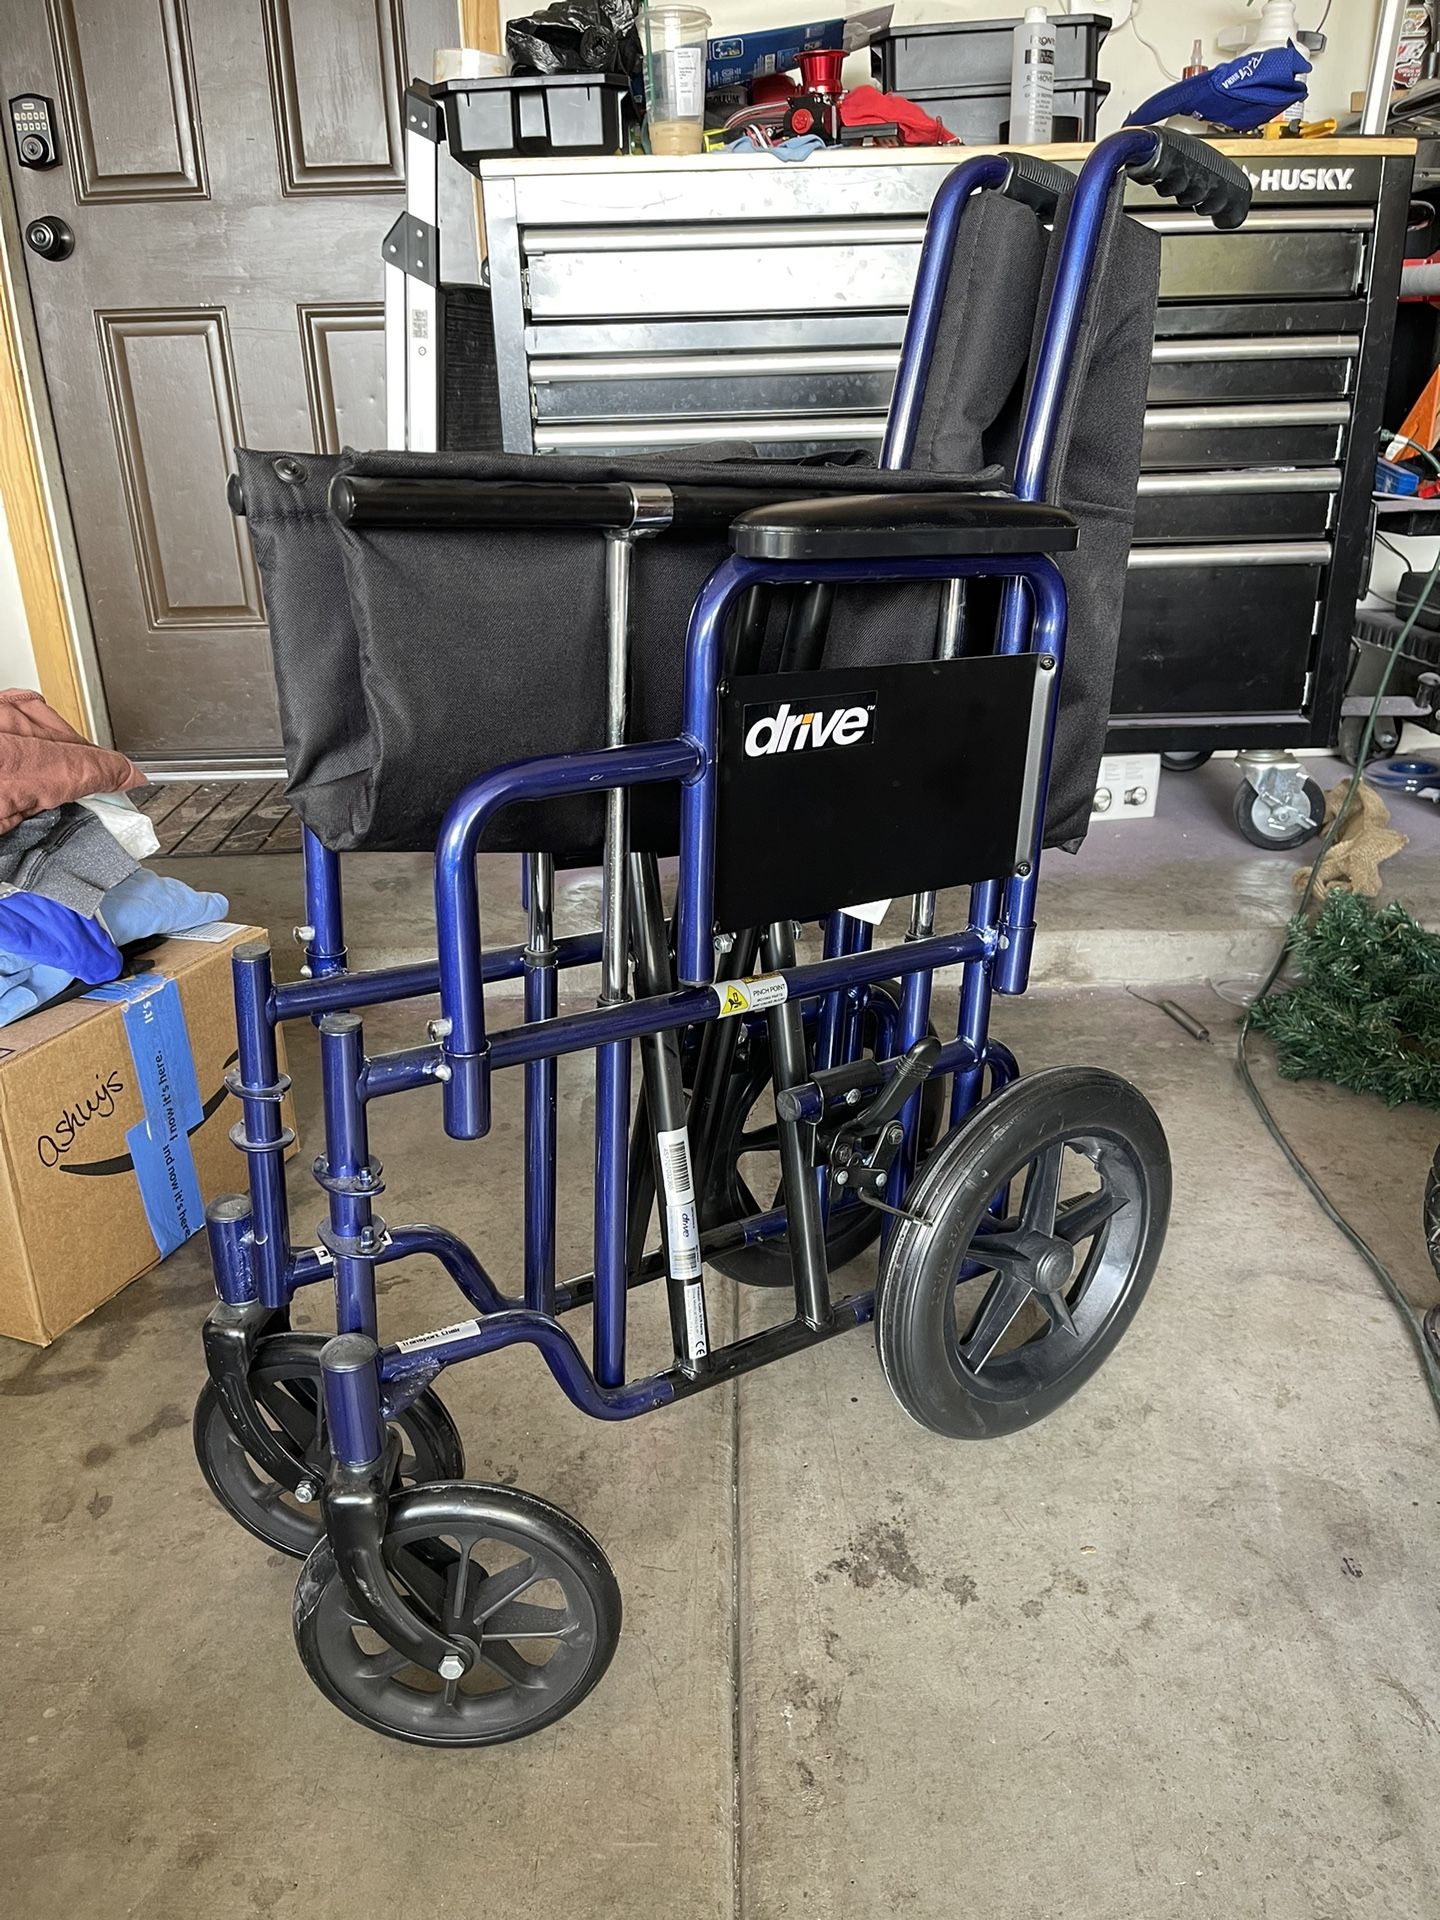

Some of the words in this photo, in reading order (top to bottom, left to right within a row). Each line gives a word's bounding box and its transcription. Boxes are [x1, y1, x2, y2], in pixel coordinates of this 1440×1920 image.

[744, 703, 869, 758] drive
[753, 988, 770, 996] PINCH
[770, 983, 786, 992] POINT
[161, 1084, 172, 1107] it's
[166, 1107, 177, 1134] now
[167, 1165, 179, 1191] now
[174, 1189, 184, 1211] it's
